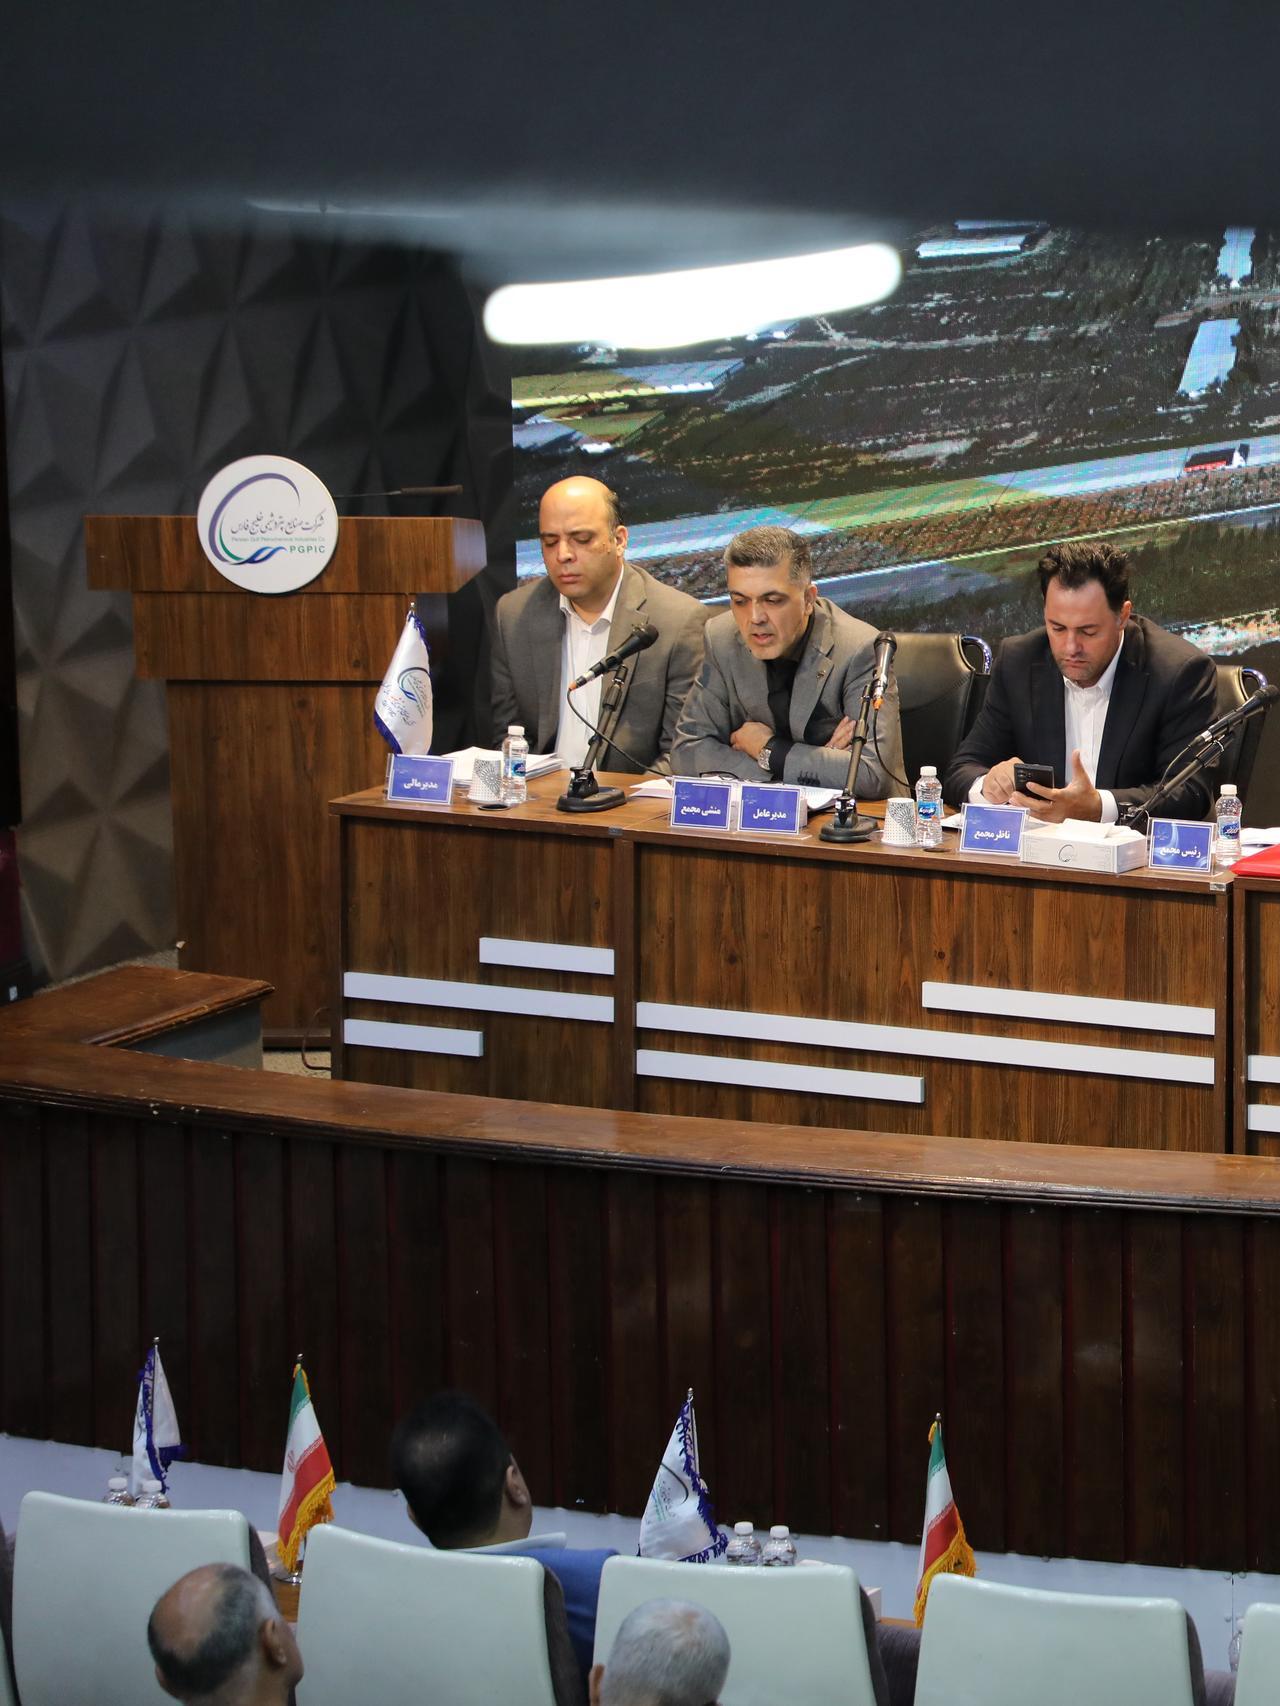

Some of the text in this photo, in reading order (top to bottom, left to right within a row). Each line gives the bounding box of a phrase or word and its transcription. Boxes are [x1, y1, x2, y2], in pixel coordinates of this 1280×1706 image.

[289, 545, 325, 553] PGPIC
[681, 804, 721, 816] منشی مجمع
[753, 808, 787, 820] مدیر عامل
[974, 829, 1011, 841] ناظر مجمع
[1160, 845, 1201, 858] رئیس مجمع
